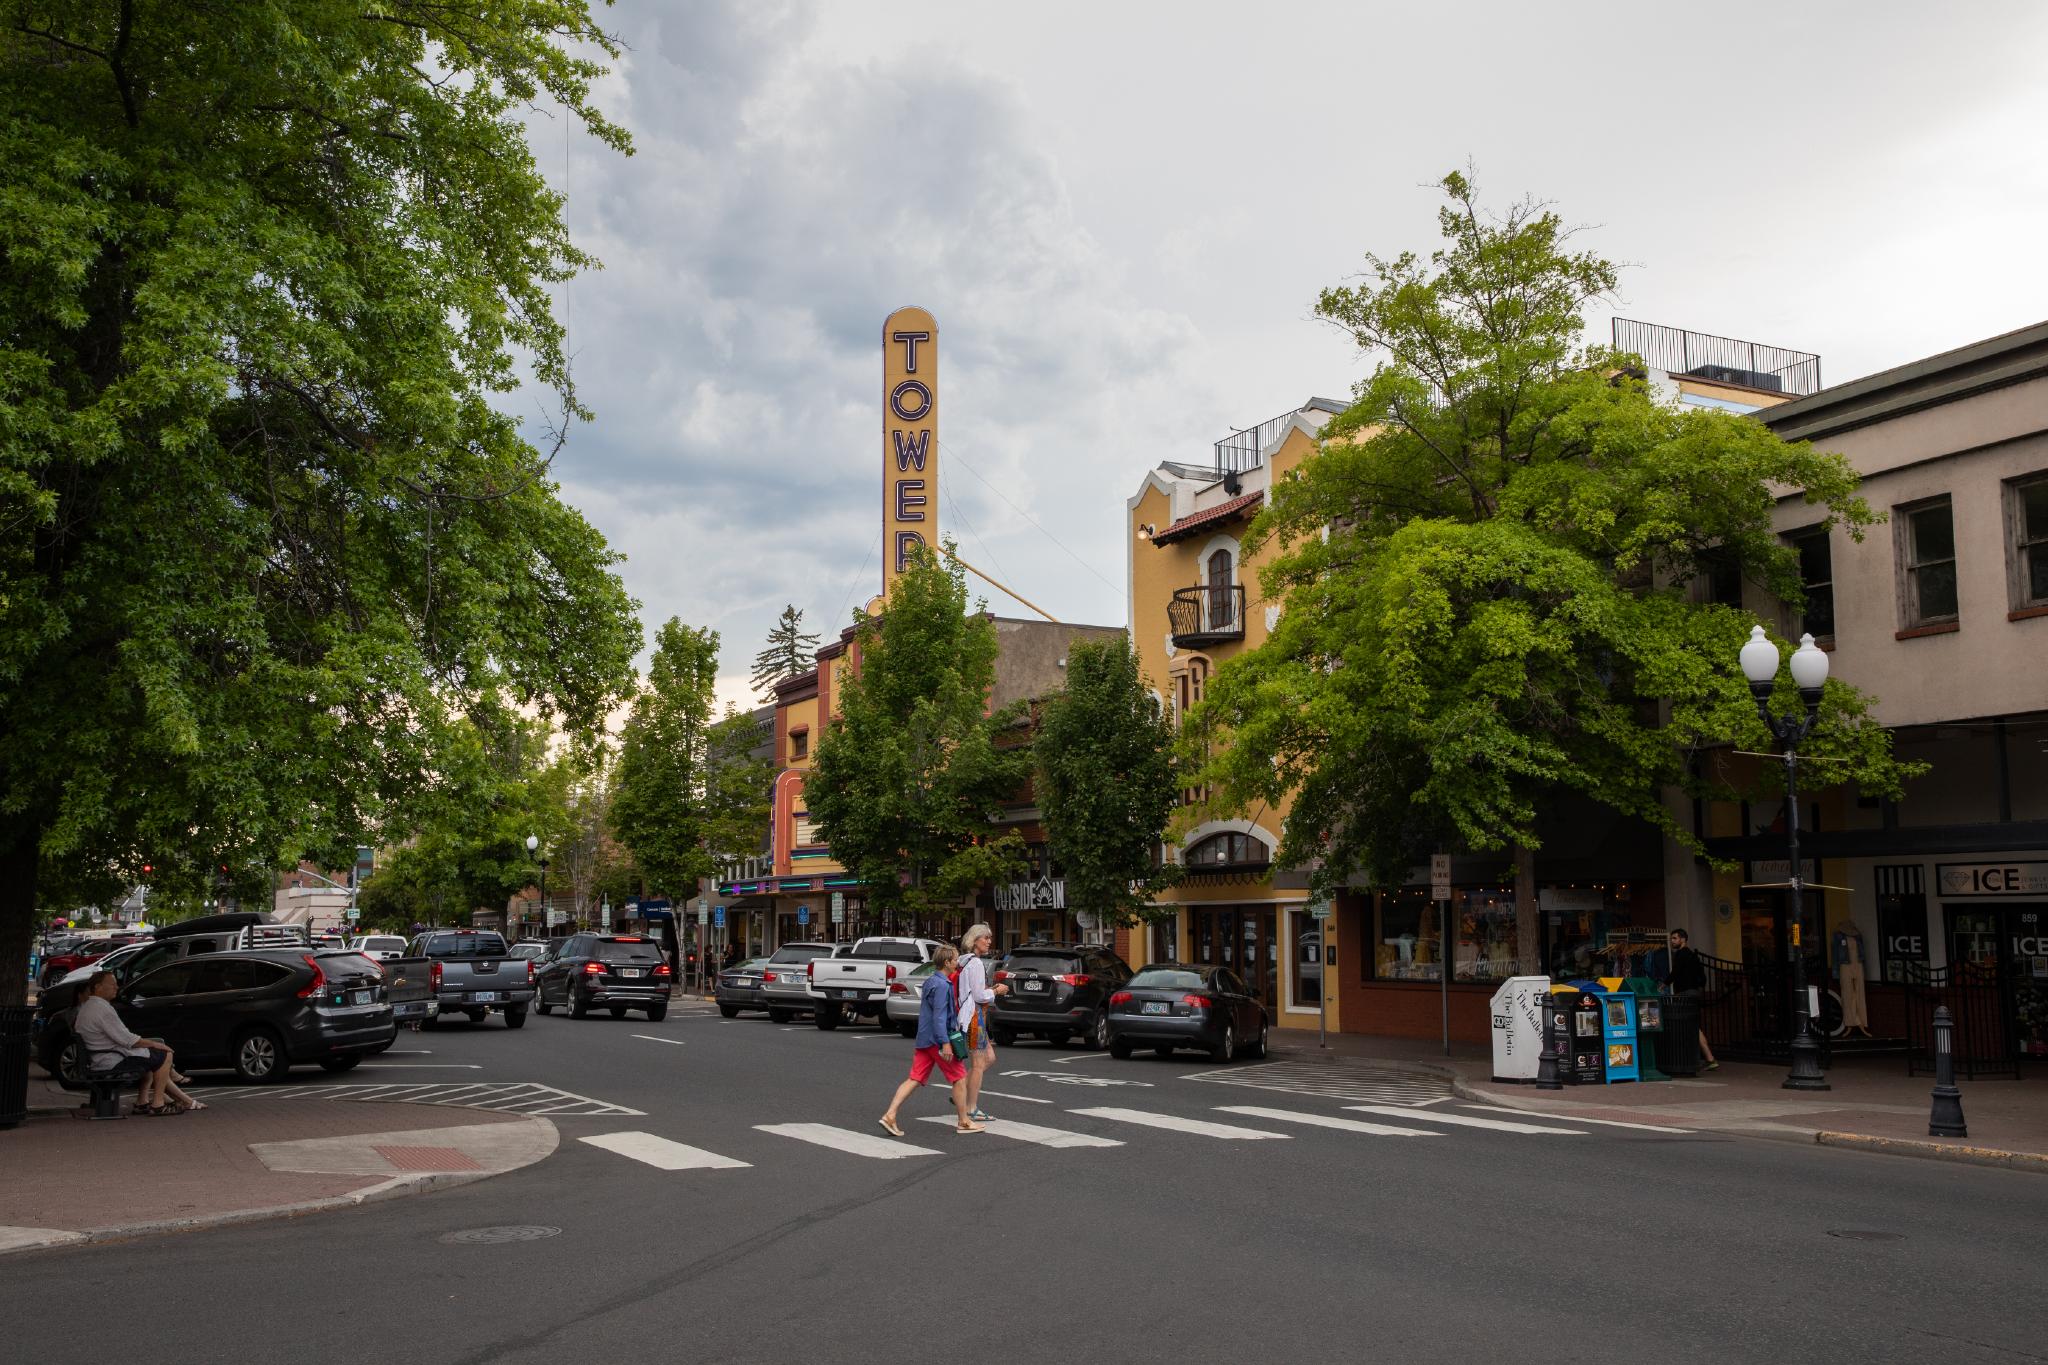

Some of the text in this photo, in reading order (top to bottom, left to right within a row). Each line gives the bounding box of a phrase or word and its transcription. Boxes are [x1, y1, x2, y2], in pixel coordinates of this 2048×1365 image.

[890, 331, 932, 573] TOWER
[1973, 869, 2019, 891] ICE
[994, 880, 1065, 911] OUTSIDE IN
[2021, 914, 2038, 923] 859
[1888, 935, 1922, 954] ICE
[2012, 937, 2048, 957] ICE
[1517, 993, 1529, 1011] The
[1505, 996, 1514, 1055] The Bulletin
